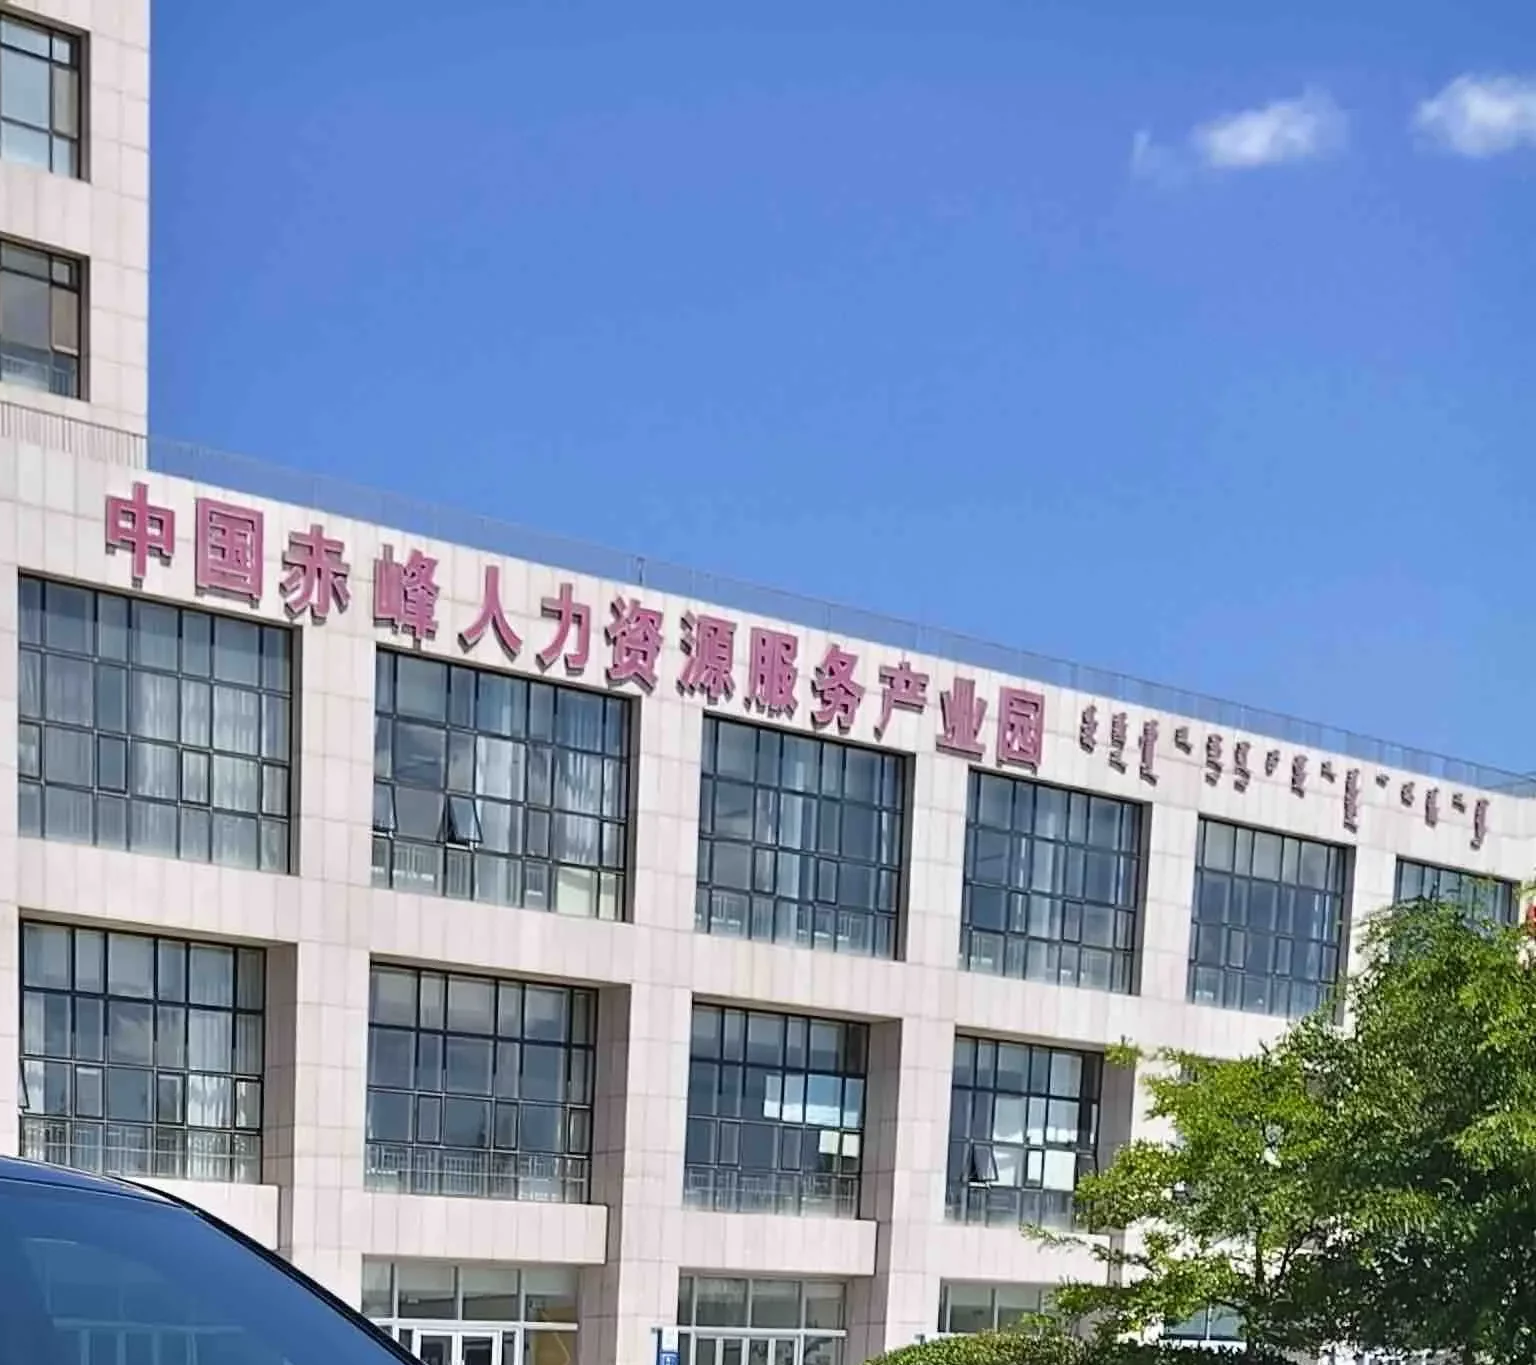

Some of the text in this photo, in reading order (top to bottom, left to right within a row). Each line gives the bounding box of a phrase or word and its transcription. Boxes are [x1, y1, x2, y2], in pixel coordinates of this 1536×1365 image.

[105, 481, 1046, 768] 中国赤峰人力资源服务产业园
